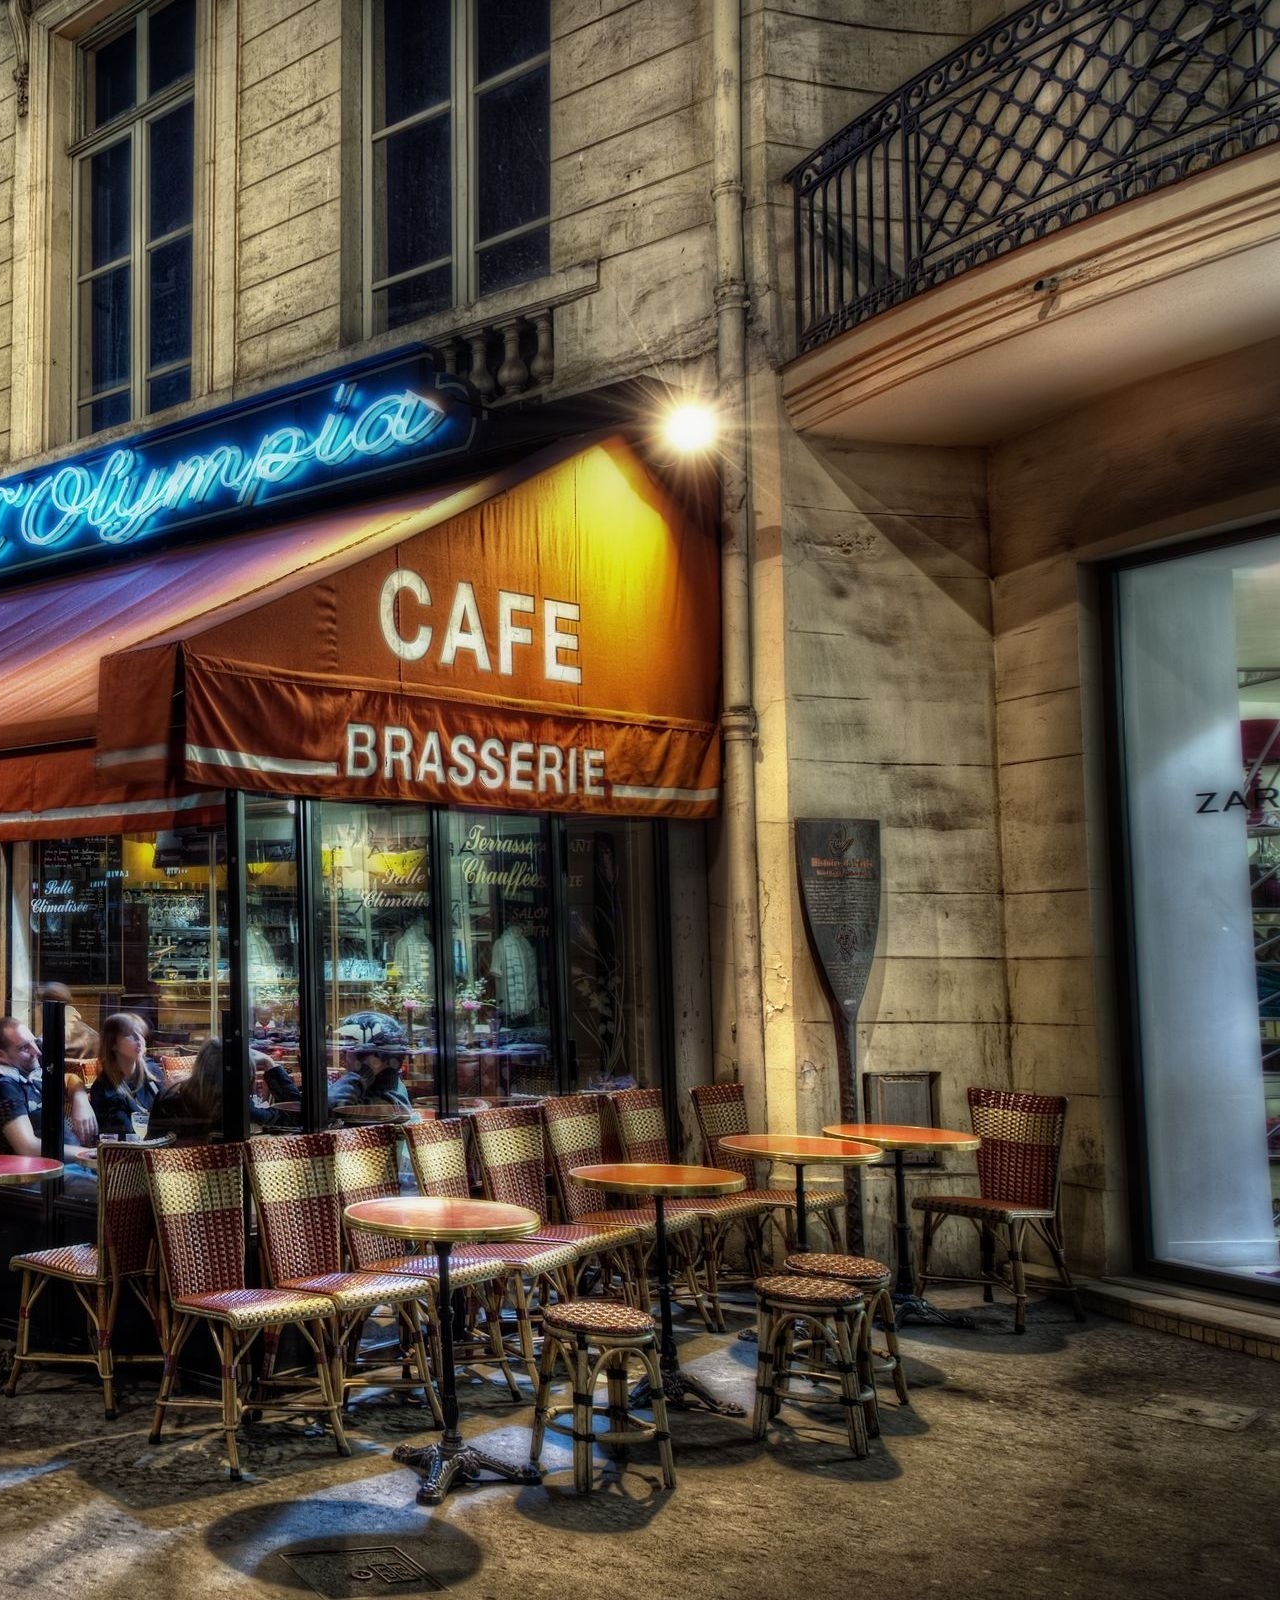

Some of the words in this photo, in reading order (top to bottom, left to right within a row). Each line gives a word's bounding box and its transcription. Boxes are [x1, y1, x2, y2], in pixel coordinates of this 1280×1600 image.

[378, 567, 583, 685] CAFE
[345, 722, 606, 797] BRASSERIE
[31, 899, 89, 913] Climatisée
[45, 879, 74, 895] Salle
